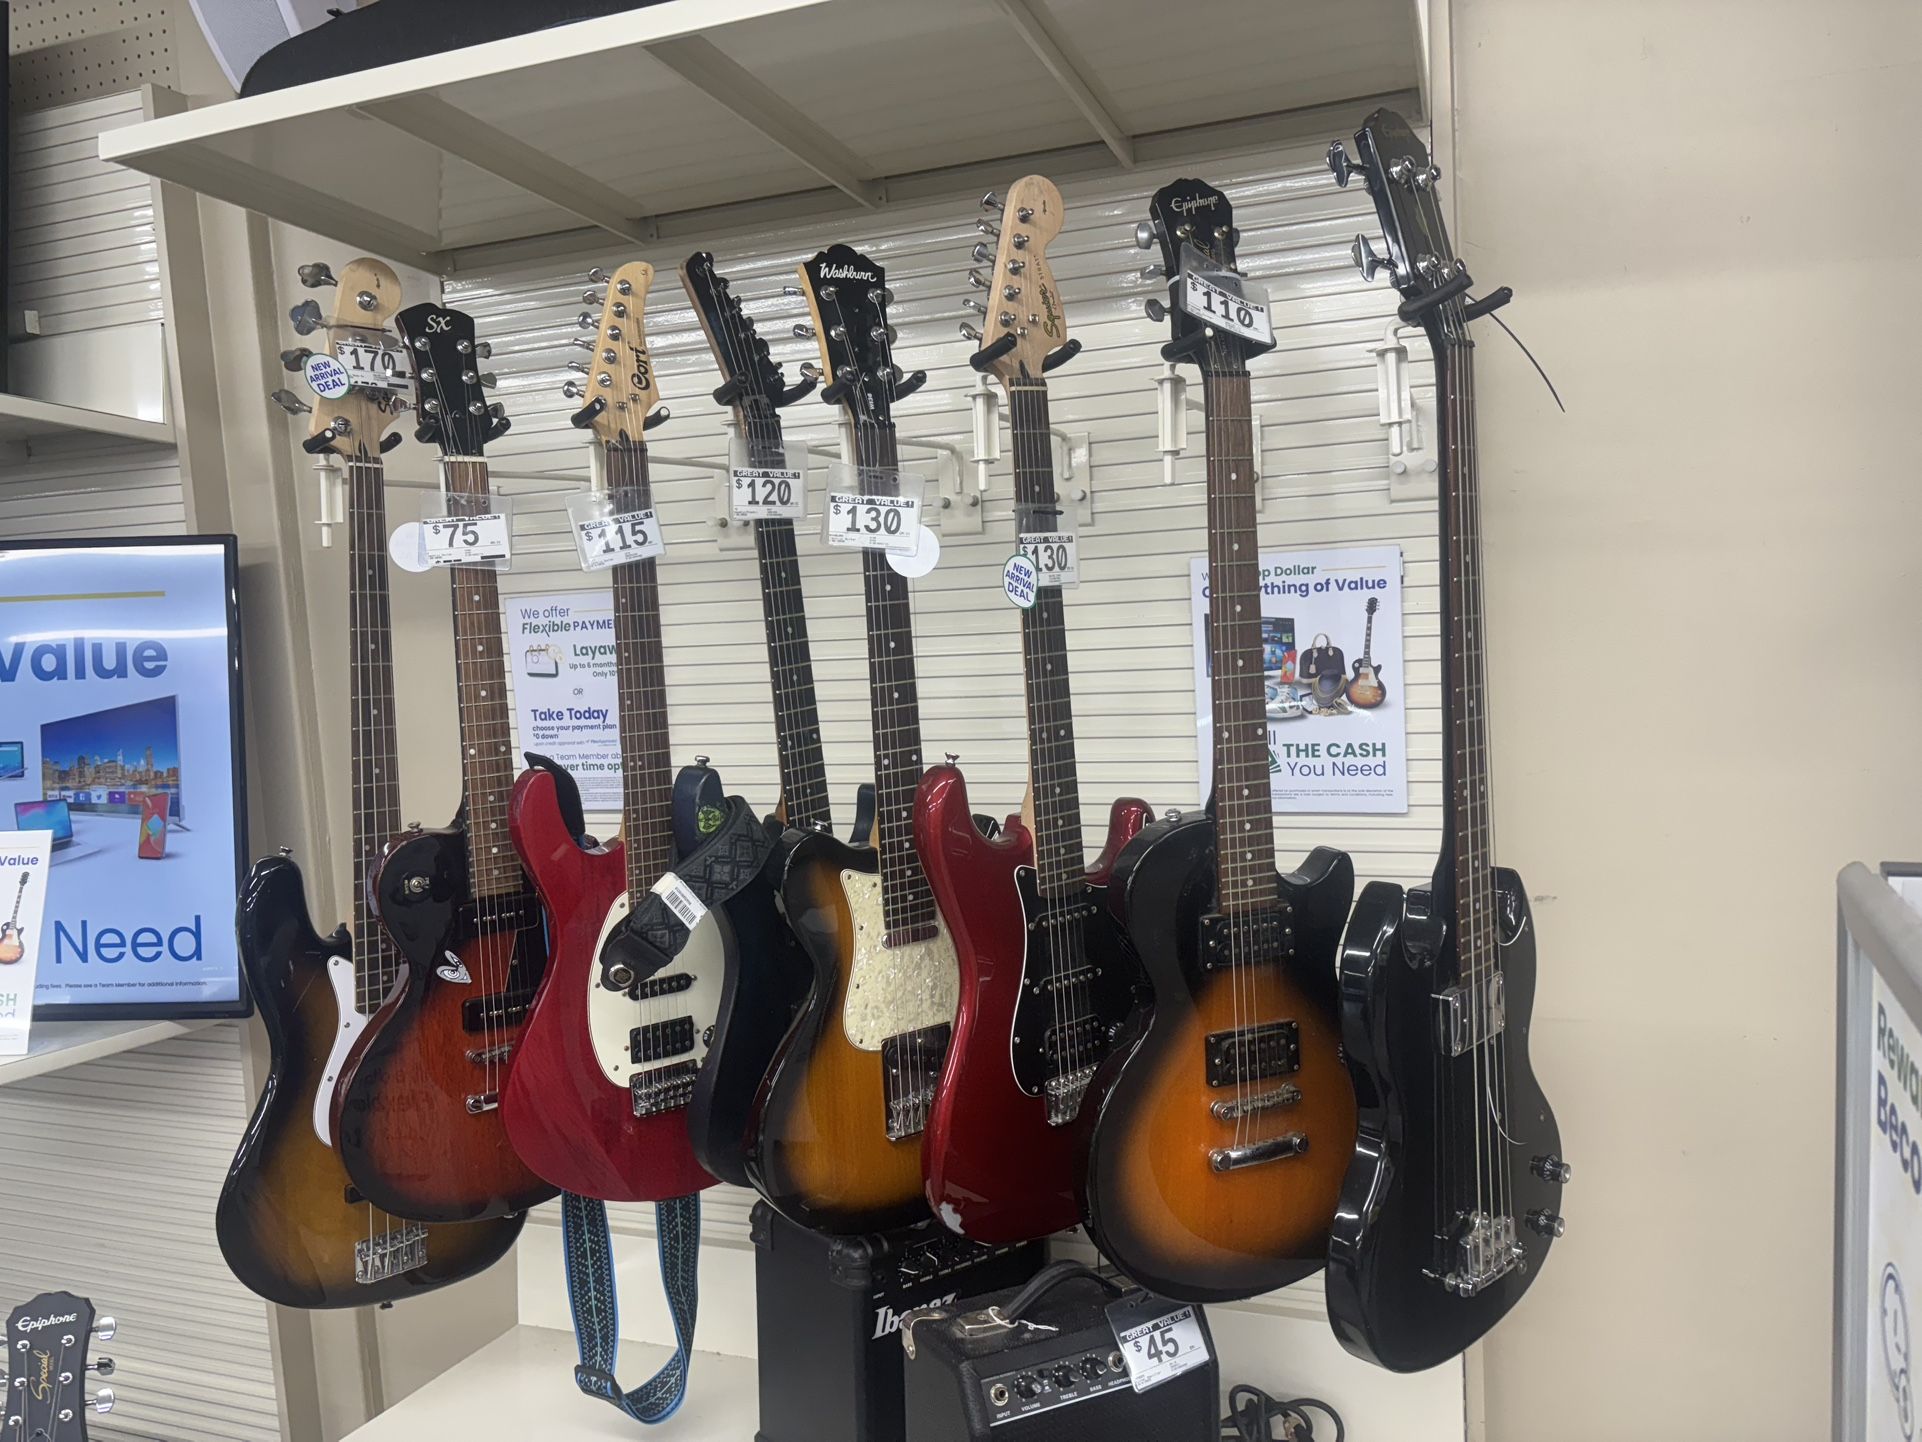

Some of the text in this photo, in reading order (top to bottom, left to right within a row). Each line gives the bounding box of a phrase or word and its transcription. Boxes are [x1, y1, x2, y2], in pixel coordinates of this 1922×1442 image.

[1169, 193, 1219, 216] Epiphone
[820, 262, 877, 282] Washburn
[1190, 282, 1254, 329] $110
[311, 360, 331, 373] NEW
[338, 346, 397, 372] $170
[628, 341, 650, 391] Cort
[309, 367, 345, 385] ARRIVAL
[317, 377, 346, 393] DEAL
[737, 470, 799, 479] GREAT VALUE!
[735, 477, 792, 506] $120
[835, 495, 914, 508] GREAT VALUE!
[620, 510, 653, 523] VALUE!
[832, 503, 902, 535] $130
[432, 522, 480, 548] $75
[584, 520, 649, 554] $115
[1022, 536, 1044, 544] GREAT
[1013, 562, 1033, 579] NEW
[1274, 565, 1317, 577] Dollar
[1005, 569, 1035, 593] ARRIVAL
[1313, 577, 1332, 593] of
[1334, 576, 1388, 592] Value
[1007, 581, 1031, 603] DEAL
[520, 605, 571, 620] We offer
[522, 618, 616, 638] Flexible PAYME
[573, 644, 617, 660] Layaw
[569, 662, 579, 671] Up
[592, 670, 608, 679] Only
[572, 688, 584, 696] OR
[531, 707, 609, 723] Take Today
[532, 722, 617, 733] choose your payment plan
[556, 753, 577, 761] Team
[578, 752, 609, 760] Member
[1282, 742, 1387, 758] THE CASH
[559, 763, 580, 771] ver
[581, 761, 605, 771] time
[1286, 760, 1387, 777] You Need
[54, 915, 203, 964] Need
[1877, 1001, 1922, 1118] Rewa
[15, 1312, 77, 1333] Epiphone
[1126, 1310, 1191, 1341] GREAT VALUE!
[1133, 1326, 1179, 1363] $45
[30, 1349, 53, 1405] Special
[1060, 1391, 1078, 1401] TREBLE
[996, 1410, 1011, 1419] INPUT
[1021, 1402, 1041, 1412] VOLUME
